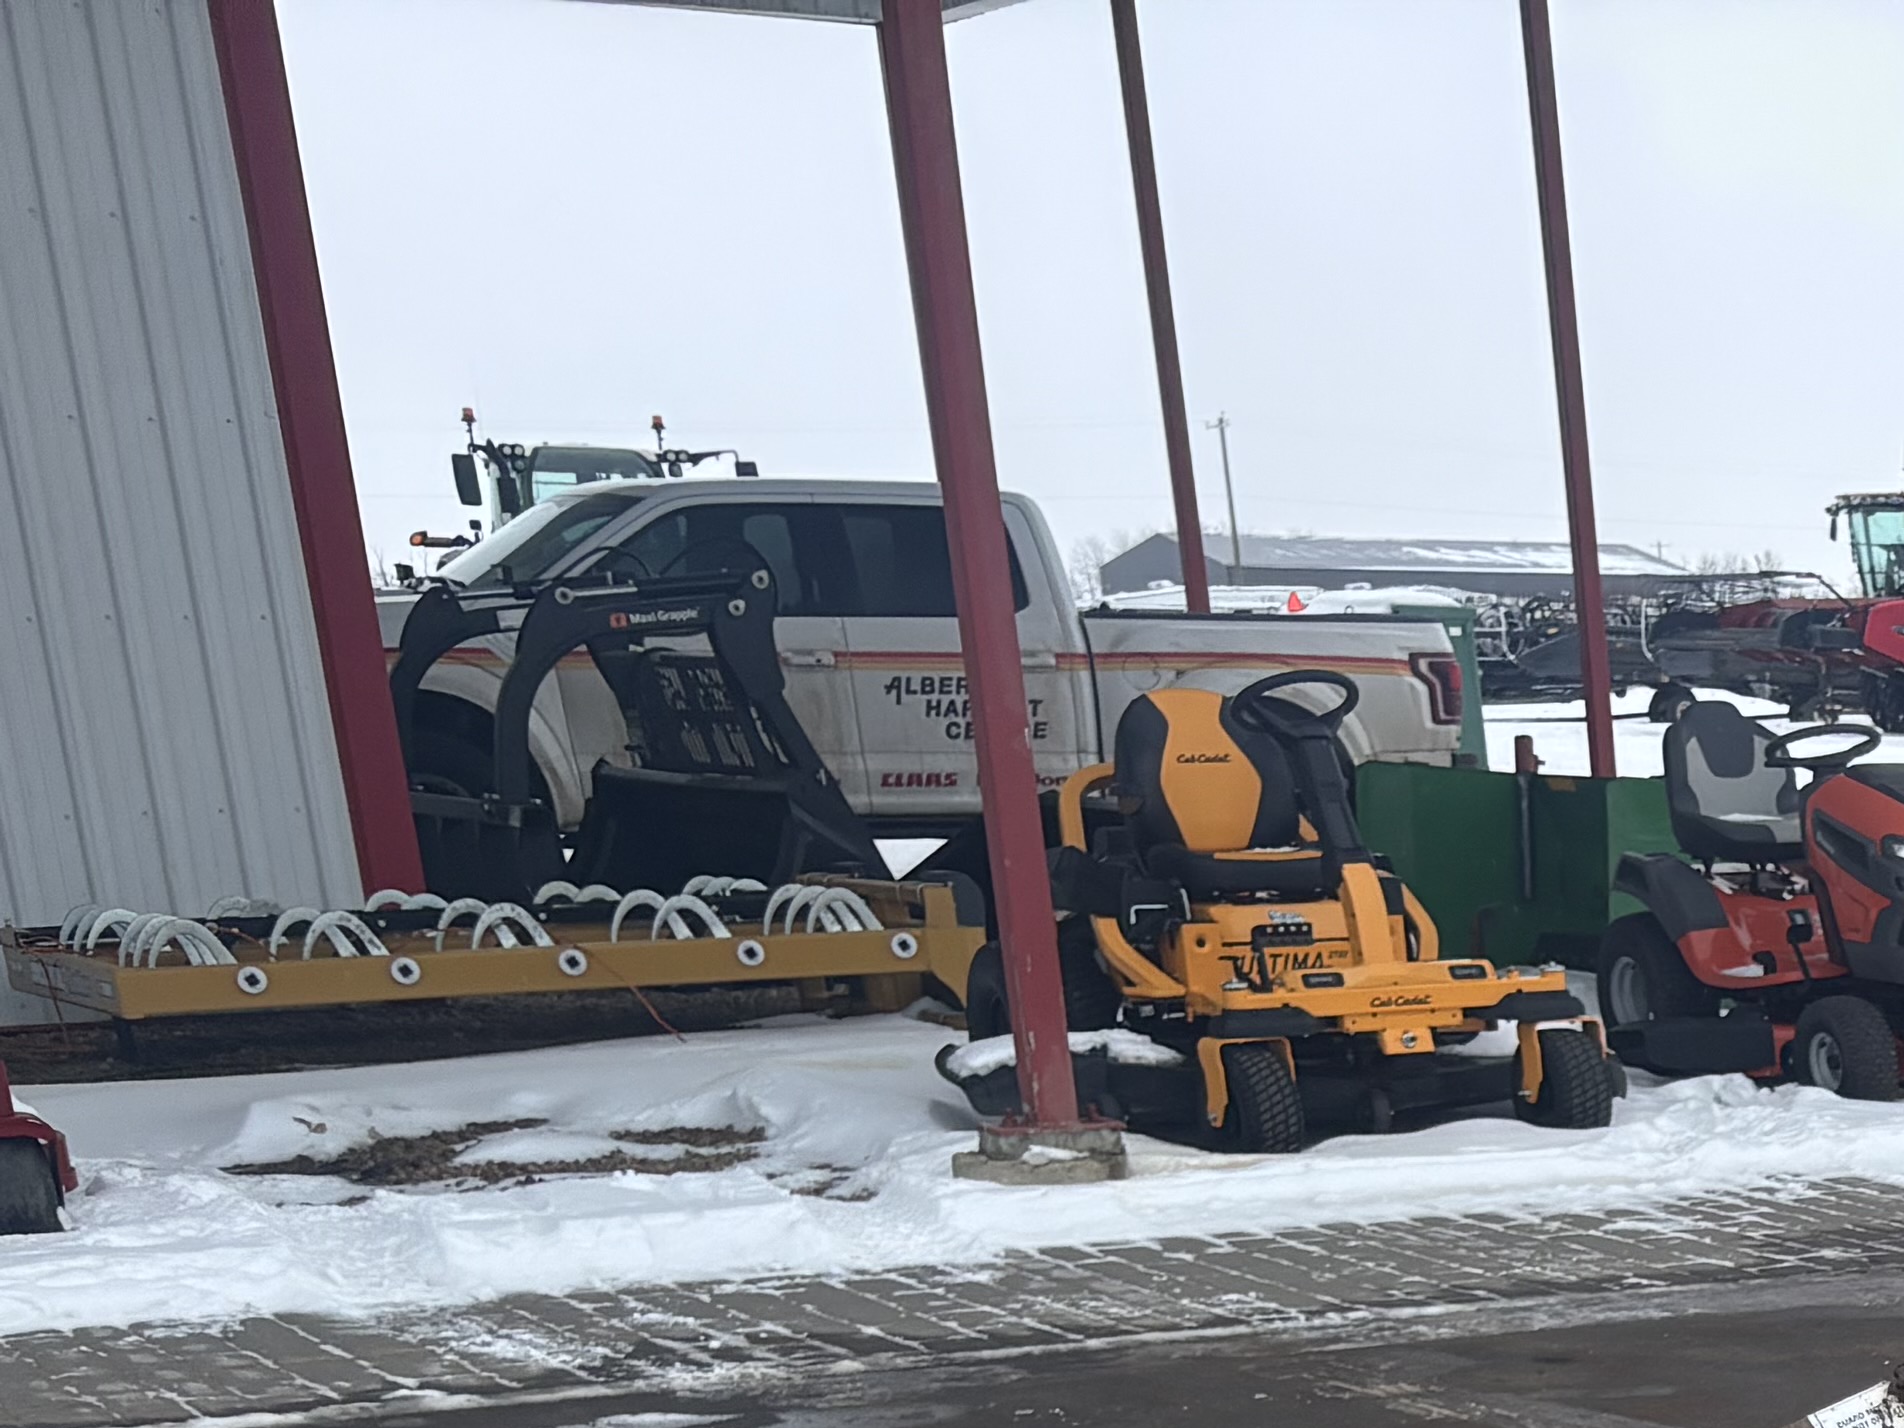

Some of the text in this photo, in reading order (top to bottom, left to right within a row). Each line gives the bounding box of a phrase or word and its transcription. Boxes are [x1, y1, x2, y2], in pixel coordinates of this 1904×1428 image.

[925, 699, 1043, 718] HART
[945, 721, 1048, 740] CEE
[880, 772, 958, 788] CLAAS
